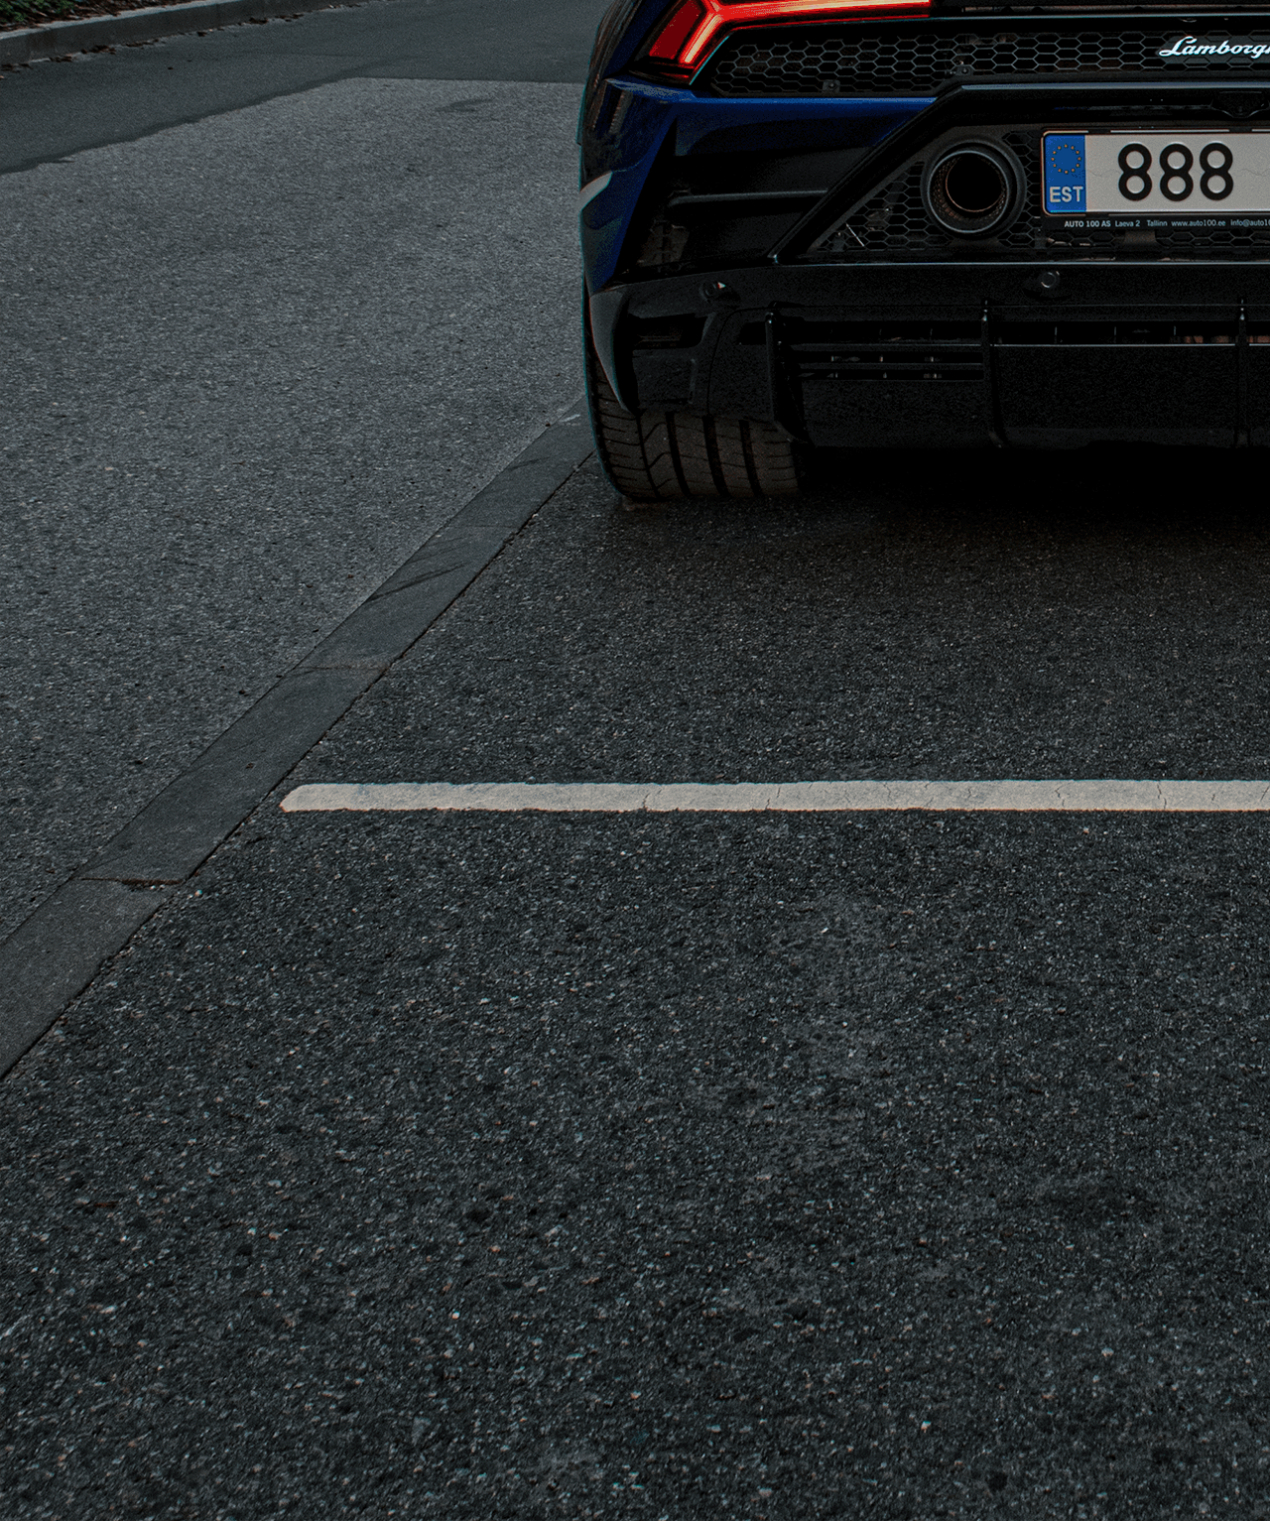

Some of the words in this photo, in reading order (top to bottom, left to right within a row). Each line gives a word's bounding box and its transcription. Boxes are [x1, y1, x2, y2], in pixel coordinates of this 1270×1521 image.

[1117, 142, 1234, 202] 888
[1049, 186, 1084, 203] EST
[1064, 220, 1084, 228] AUTO
[1086, 220, 1100, 228] 100
[1101, 220, 1111, 228] AS
[1147, 219, 1167, 227] Tallinn
[1171, 219, 1226, 227] www.auto100.ee
